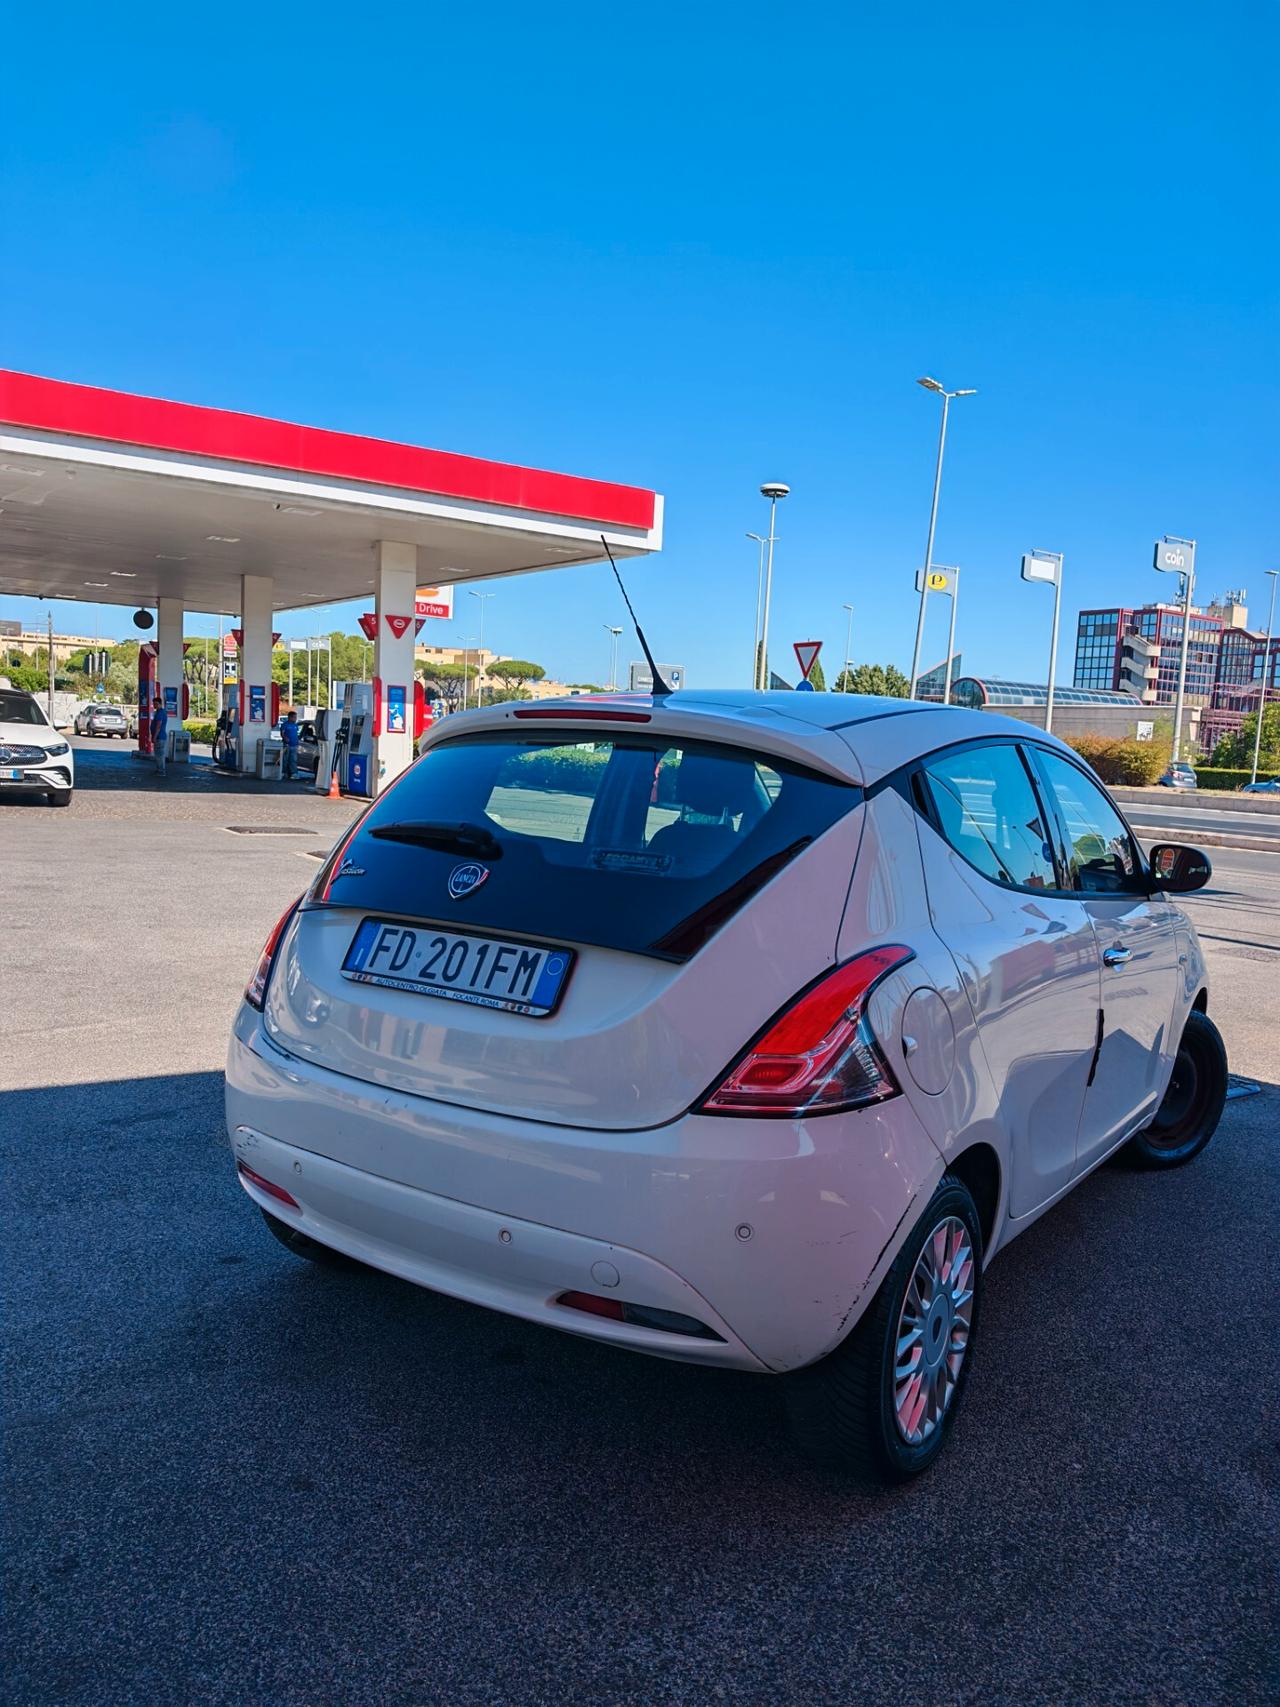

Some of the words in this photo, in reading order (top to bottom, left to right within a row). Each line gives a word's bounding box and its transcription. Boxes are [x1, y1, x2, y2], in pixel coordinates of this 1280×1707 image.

[1165, 549, 1185, 567] coin
[418, 602, 444, 615] Drive
[454, 872, 477, 884] LANCIA
[368, 928, 417, 972] FD
[375, 977, 419, 992] AUTOCENTRO
